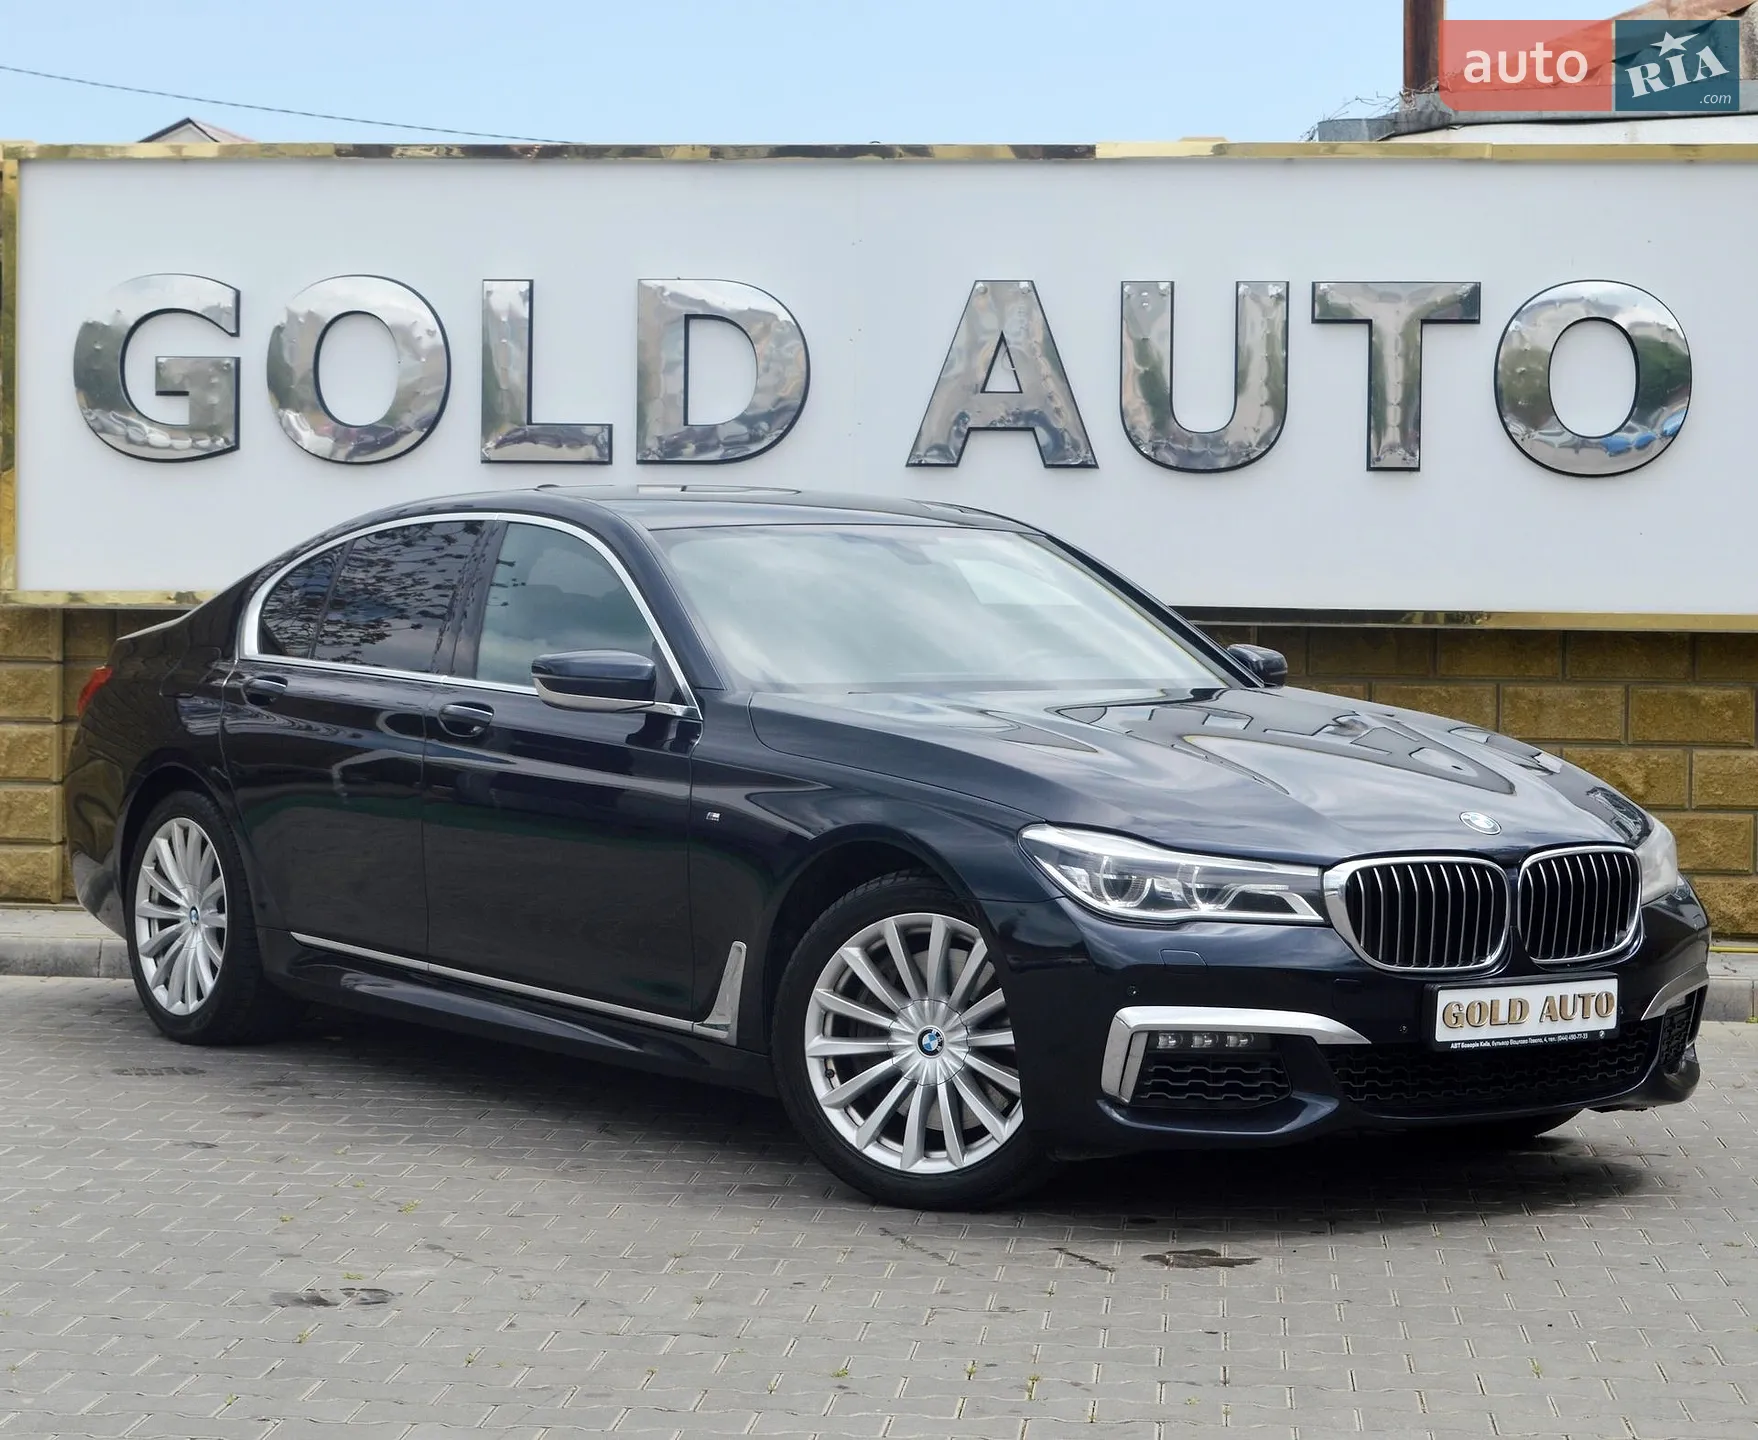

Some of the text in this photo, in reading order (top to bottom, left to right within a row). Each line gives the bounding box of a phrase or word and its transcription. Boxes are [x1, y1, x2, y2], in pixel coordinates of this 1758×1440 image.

[73, 272, 1692, 478] GOLD AUTO
[1442, 990, 1615, 1029] GOLD AUTO
